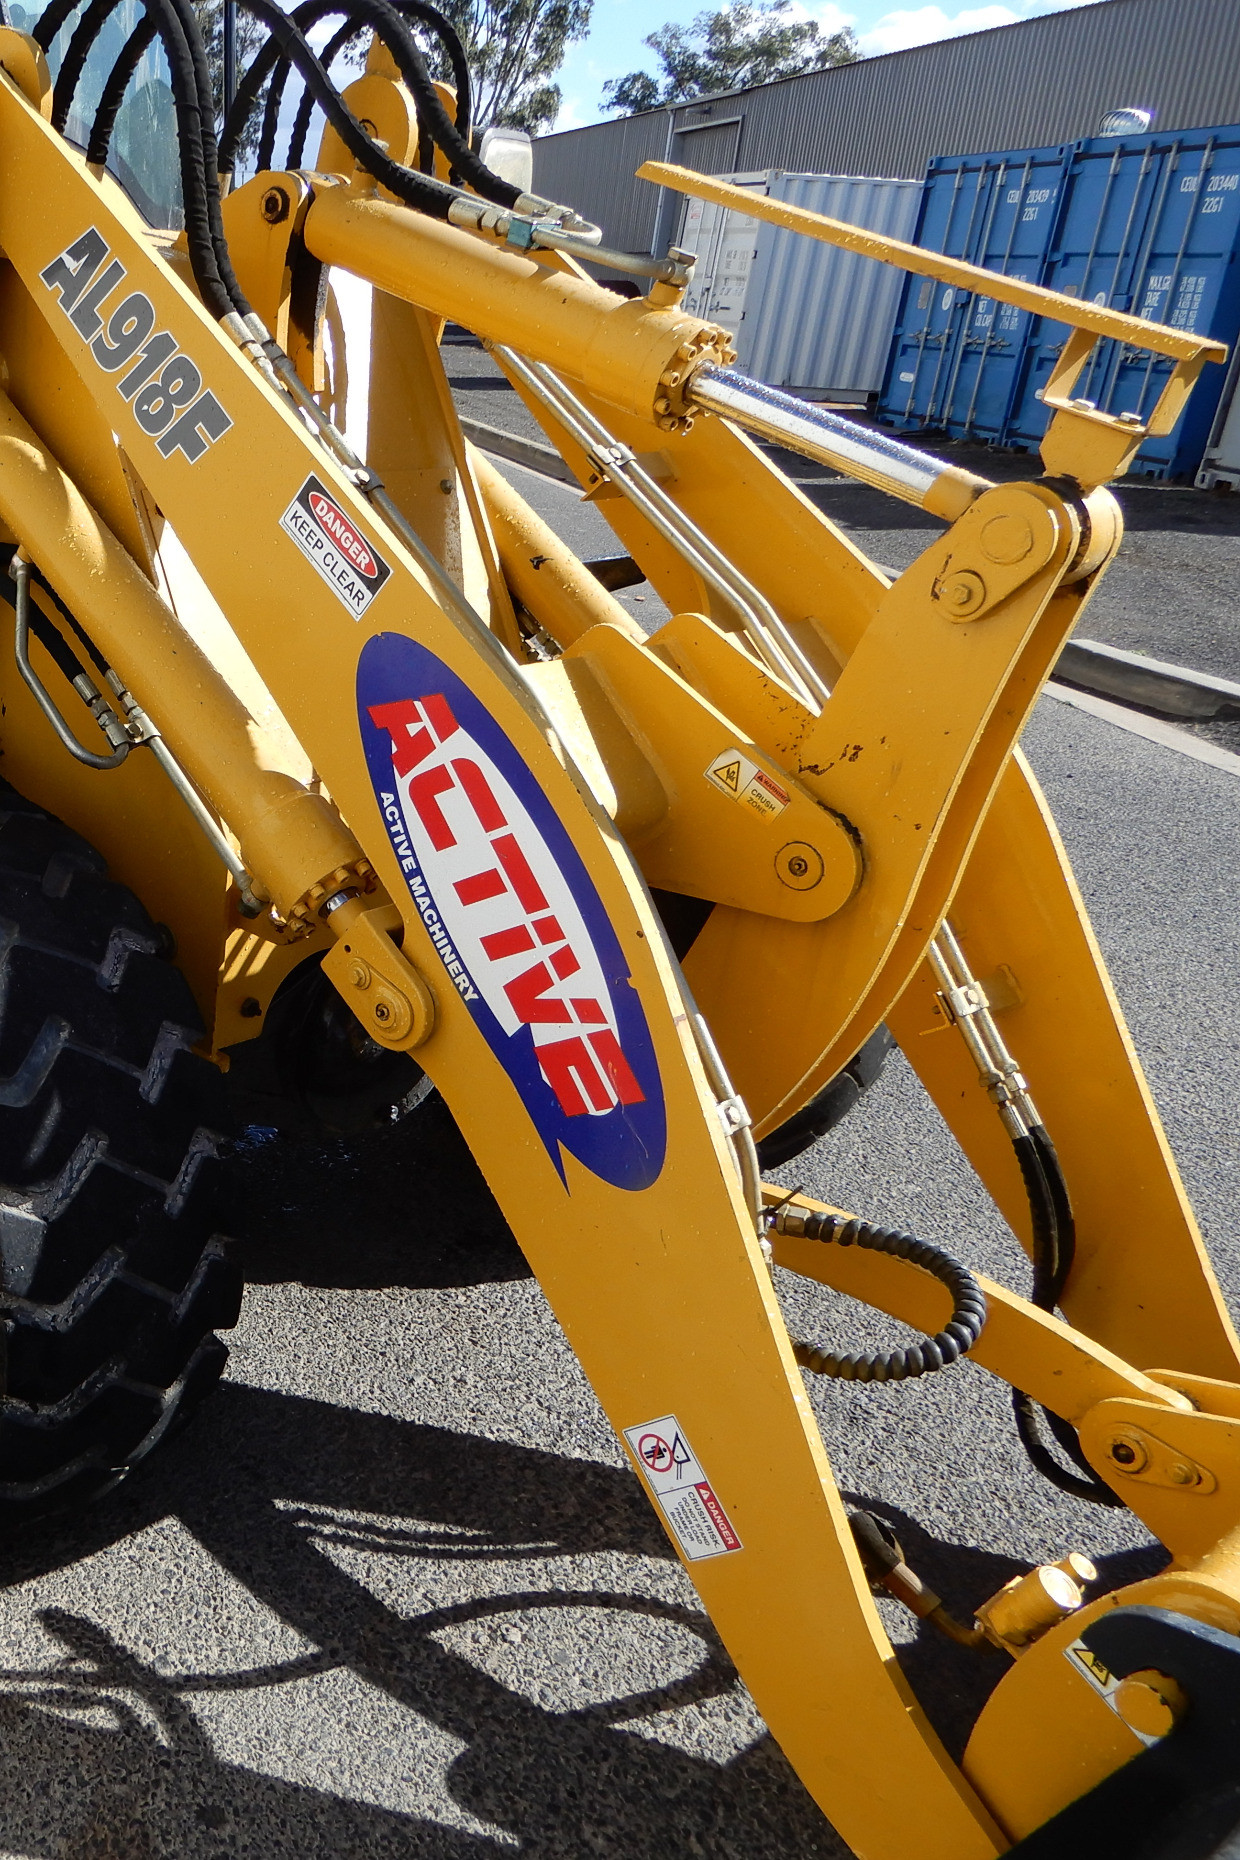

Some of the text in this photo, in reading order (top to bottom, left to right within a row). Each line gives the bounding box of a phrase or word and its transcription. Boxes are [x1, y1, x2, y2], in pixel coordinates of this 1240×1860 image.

[1202, 197, 1224, 213] 22G1
[38, 225, 235, 465] AL918F
[315, 499, 370, 570] DANGER
[289, 510, 324, 551] KEEP
[323, 552, 365, 607] CLEAR
[750, 788, 777, 812] CRUSH
[380, 792, 480, 1001] ACTIVE MACHINERY
[674, 1506, 690, 1532] FRAME
[677, 1501, 703, 1545] UNDER LOAD
[687, 1491, 709, 1524] CRUSH
[687, 1507, 699, 1523] NOT
[695, 1522, 711, 1547] STAND
[707, 1501, 735, 1545] DANGER
